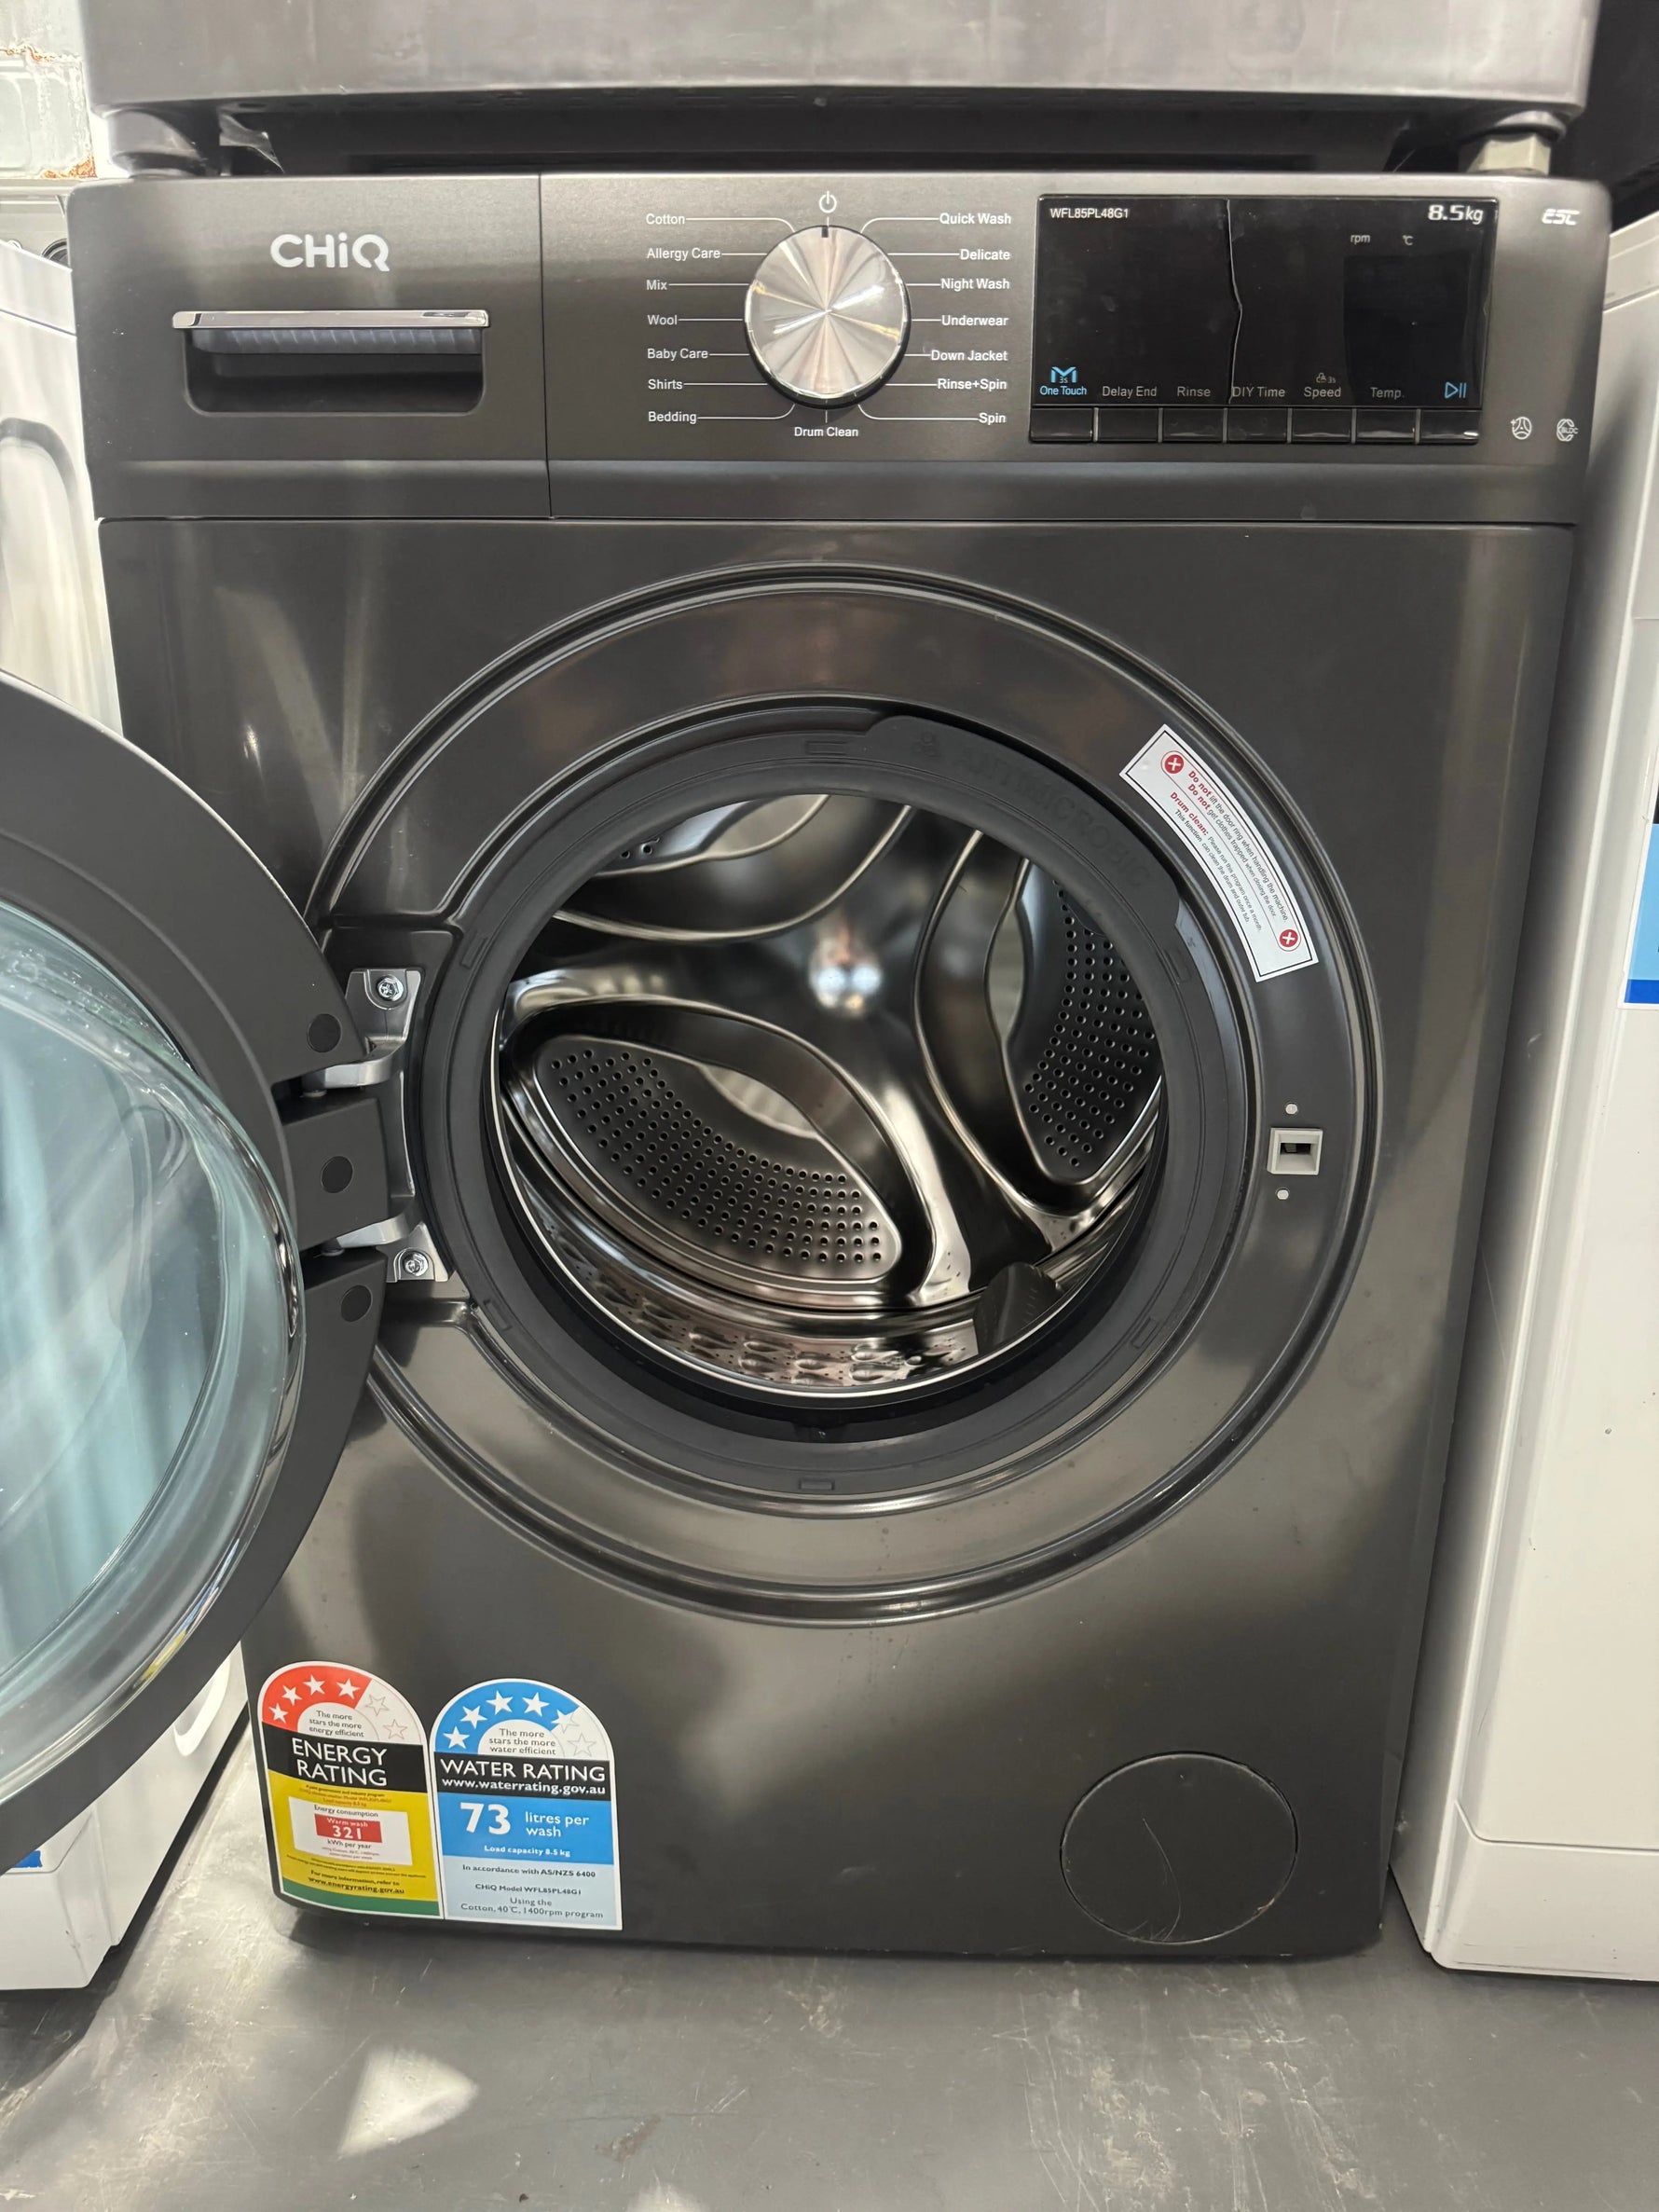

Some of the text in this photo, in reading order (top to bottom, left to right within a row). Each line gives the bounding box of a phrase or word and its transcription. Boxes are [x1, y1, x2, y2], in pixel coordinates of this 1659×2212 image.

[645, 213, 686, 225] Cotton
[939, 212, 1012, 225] Quick Wash
[1049, 207, 1129, 219] WFL85PL48G1
[1427, 204, 1484, 225] 8.5kg
[1350, 234, 1371, 245] rpm
[269, 231, 391, 272] CHiQ
[646, 247, 721, 262] Allergy Care
[959, 248, 1010, 260] Delicate
[645, 279, 668, 291] Mix
[939, 277, 1010, 292] Night Wash
[647, 314, 678, 325] Wool
[940, 314, 1009, 326] Underwear
[647, 348, 708, 362] Baby Care
[930, 349, 1009, 362] Down Jacket
[648, 378, 683, 390] Shirts
[937, 378, 1008, 392] Rinse+Spin
[1039, 385, 1088, 395] One Touch
[1102, 385, 1158, 399] Delay End
[1176, 386, 1211, 397] Rinse
[1232, 386, 1286, 397] DIY Time
[1304, 387, 1342, 400] Speed
[1370, 387, 1405, 400] Temp.
[648, 410, 697, 425] Bedding
[978, 411, 1008, 426] Spin
[793, 426, 859, 437] Drum Clean
[1187, 783, 1199, 796] Do
[1198, 796, 1211, 810] not
[1206, 809, 1217, 820] get
[1215, 817, 1232, 840] clothes
[1230, 839, 1249, 863] trapped
[1245, 861, 1255, 877] when
[1254, 877, 1266, 896] closing
[1188, 770, 1288, 922] Do not lift the door ring when handling the machine.
[1170, 791, 1190, 814] Drum
[1188, 812, 1209, 836] clean:
[1208, 836, 1221, 855] Please
[1225, 862, 1233, 873] this
[1231, 873, 1245, 896] program
[1243, 895, 1252, 909] once
[1174, 809, 1186, 821] This
[1184, 820, 1202, 843] function
[1201, 843, 1210, 853] can
[1209, 852, 1220, 866] clean
[1217, 865, 1226, 875] the
[1223, 875, 1233, 889] drum
[1230, 888, 1240, 900] and
[1236, 899, 1245, 913] outer
[316, 1710, 331, 1719] The
[308, 1718, 363, 1730] stars the more
[308, 1726, 364, 1738] energy efficient
[499, 1727, 545, 1738] The more
[514, 1738, 528, 1746] the
[292, 1737, 388, 1766] ENERGY
[518, 1747, 556, 1755] efficient
[296, 1758, 388, 1787] RATING
[440, 1758, 606, 1782] WATER RATING
[441, 1777, 606, 1795] www.waterrating.gov.au
[314, 1804, 378, 1818] Energy consumption
[326, 1817, 350, 1826] Warm
[459, 1801, 512, 1835] 73
[525, 1811, 590, 1828] litres per
[332, 1825, 362, 1840] 321
[526, 1825, 562, 1837] wash
[327, 1838, 344, 1847] kWh
[484, 1845, 571, 1858] Load capacity 8.5 kg
[322, 1872, 337, 1880] more
[473, 1865, 520, 1875] accordance
[521, 1867, 540, 1875] with
[541, 1868, 574, 1877] AS/NZS
[576, 1870, 596, 1878] 6400
[308, 1876, 404, 1894] www.energyrating.gov.au
[474, 1883, 498, 1892] CHiQ
[524, 1886, 582, 1895] WFL85PL48G1
[510, 1897, 553, 1907] Using the
[460, 1903, 497, 1913] Cotton,
[523, 1906, 563, 1917] 1400rpm
[565, 1910, 604, 1919] program
